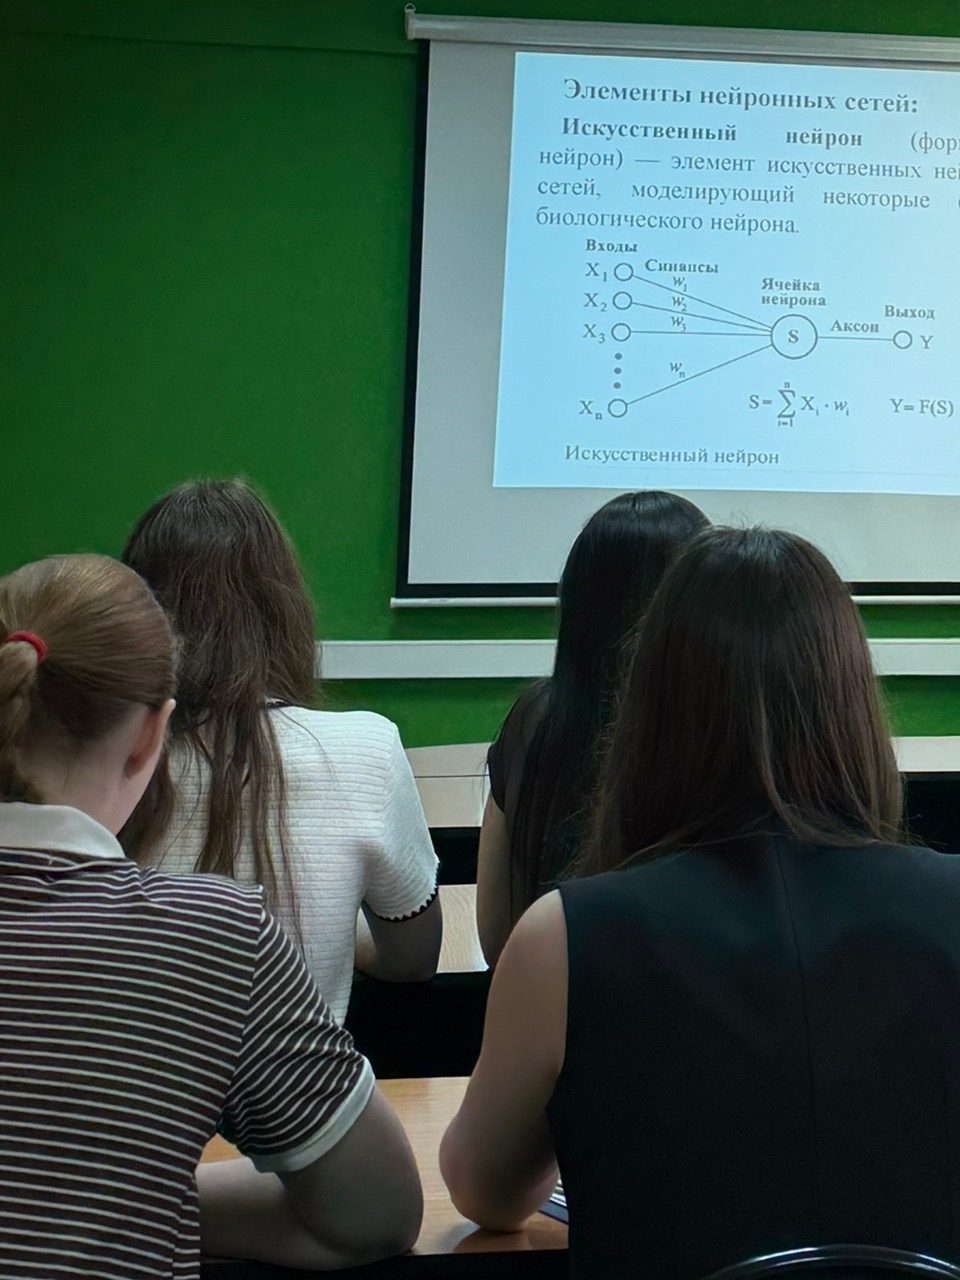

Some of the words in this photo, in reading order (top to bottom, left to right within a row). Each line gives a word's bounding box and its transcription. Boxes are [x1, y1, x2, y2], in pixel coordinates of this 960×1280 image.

[564, 78, 691, 103] Элементы
[700, 87, 837, 110] нейронных
[845, 94, 918, 113] сетей:
[562, 118, 736, 141] Искусственный
[786, 129, 862, 149] нейрон
[539, 148, 623, 170] нейрон)
[671, 155, 755, 171] элемент
[767, 159, 922, 178] искусственных
[538, 178, 601, 198] сетей,
[632, 184, 795, 205] моделирующий
[823, 191, 930, 211] некоторые
[536, 206, 703, 230] биологического
[710, 213, 799, 236] нейрона.
[586, 239, 638, 253] Входы
[645, 259, 719, 273] Синапсы
[761, 277, 821, 291] Ячейка
[761, 293, 826, 308] нейрона
[884, 304, 935, 320] Выход
[830, 319, 879, 333] Аксон
[788, 329, 800, 344] S
[920, 335, 934, 349] Y
[565, 445, 708, 464] Искусственный
[714, 449, 779, 467] нейрон
